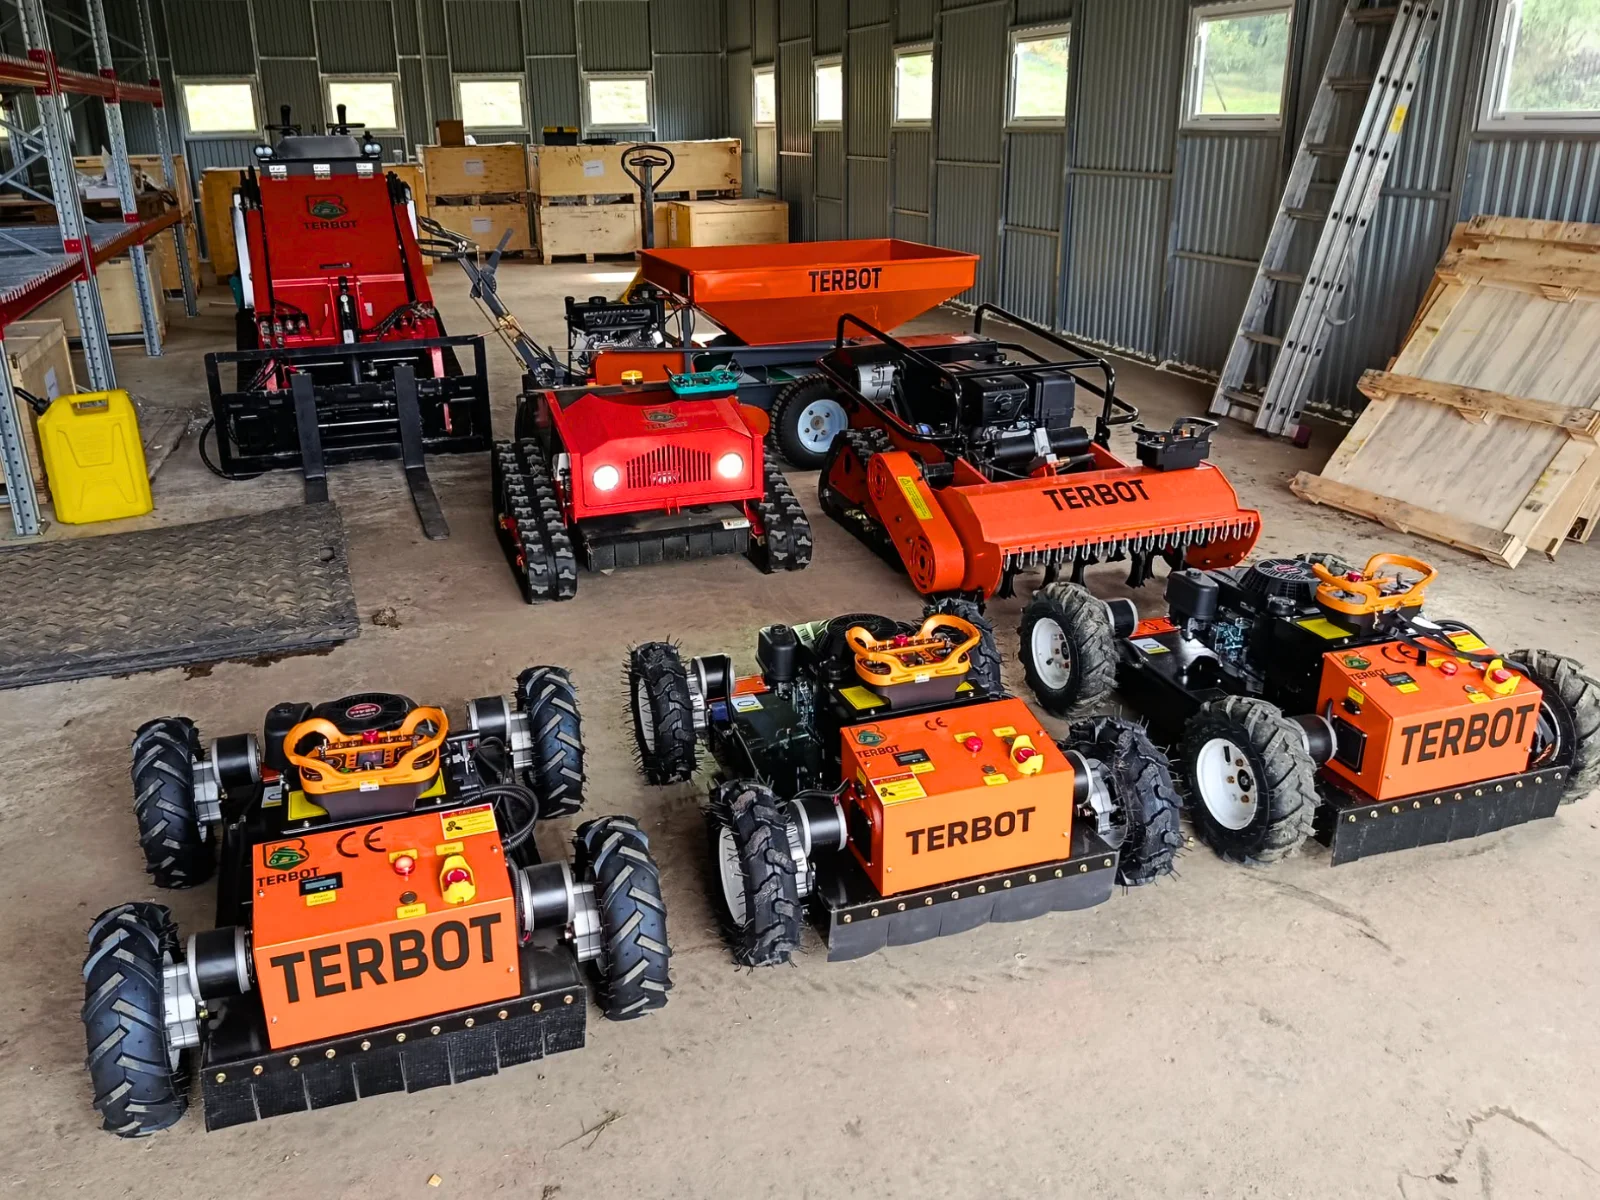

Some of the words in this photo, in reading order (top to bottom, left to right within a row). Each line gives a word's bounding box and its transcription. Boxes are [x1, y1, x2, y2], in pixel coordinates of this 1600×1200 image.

[303, 220, 357, 230] TERBOT
[808, 267, 882, 293] TERBOT
[1042, 479, 1150, 511] TERBOT
[1348, 668, 1389, 681] TERBOT
[924, 717, 948, 731] CE
[1401, 703, 1535, 766] TERBOT
[856, 745, 900, 759] TERBOT
[336, 826, 386, 858] CE
[906, 806, 1036, 855] TERBOT
[256, 867, 320, 888] TERBOT
[270, 913, 501, 1004] TERBOT
